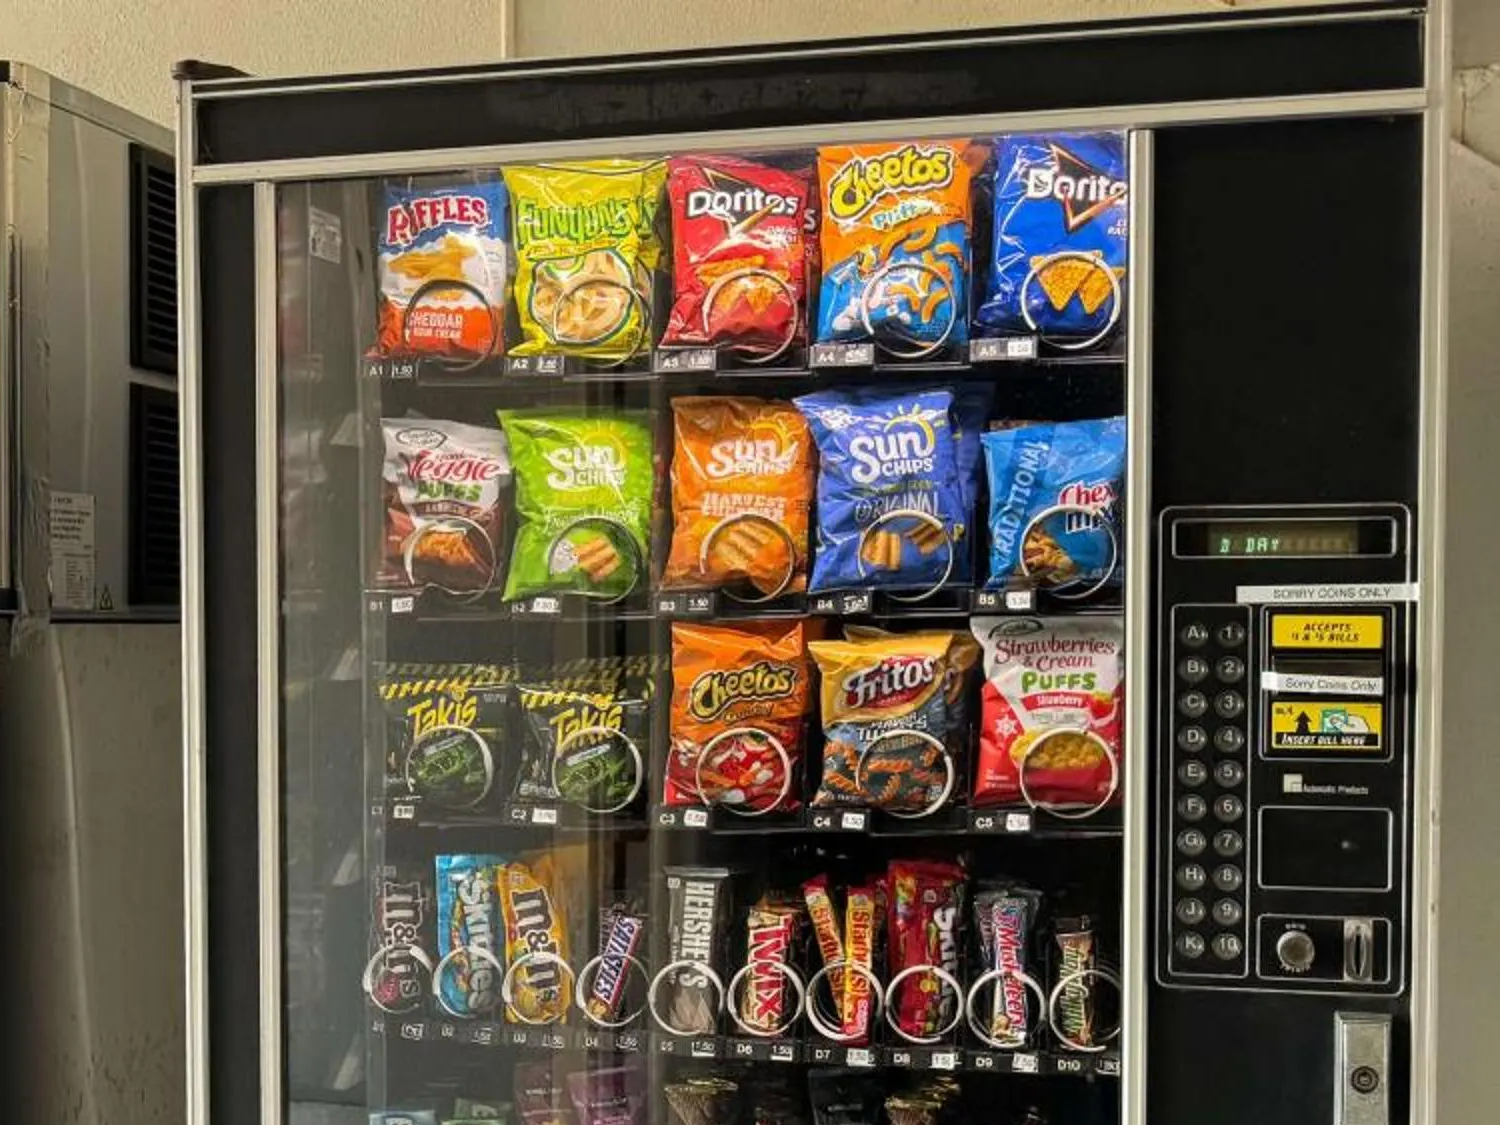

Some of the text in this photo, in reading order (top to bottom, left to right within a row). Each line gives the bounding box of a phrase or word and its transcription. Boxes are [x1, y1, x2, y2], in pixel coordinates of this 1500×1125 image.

[828, 144, 952, 220] Cheetos
[687, 187, 800, 217] Doritos
[512, 358, 528, 369] A2
[850, 429, 924, 484] Sun
[882, 457, 933, 475] CHIPS
[1059, 480, 1119, 507] Chex
[1245, 537, 1281, 553] DAY
[1317, 588, 1356, 600] COINS
[1359, 587, 1392, 599] ONLY
[1187, 625, 1199, 638] A
[1224, 626, 1232, 638] 1
[1303, 623, 1351, 632] ACCEPTS
[994, 636, 1116, 666] Strawberries
[1036, 653, 1097, 669] Cream
[1187, 660, 1199, 673] B
[1224, 661, 1235, 673] 2
[843, 655, 938, 710] Fritos
[1020, 671, 1097, 693] PUFFS
[692, 663, 792, 718] Cheetos
[1187, 695, 1199, 707] C
[1223, 695, 1234, 708] 3
[408, 694, 477, 739] Takis
[549, 704, 623, 748] Takis
[1187, 730, 1199, 742] D
[1222, 730, 1234, 743] 4
[1187, 764, 1198, 777] E
[1223, 764, 1234, 777] 5
[1187, 799, 1198, 812] F
[1223, 799, 1234, 812] 6
[814, 816, 831, 827] C4
[975, 816, 993, 828] C5
[1185, 834, 1198, 847] G
[1222, 834, 1233, 847] 7
[1185, 868, 1198, 880] H
[1222, 868, 1233, 881] 8
[1185, 902, 1196, 915] J
[1222, 903, 1233, 916] 9
[1185, 937, 1198, 949] K
[1219, 937, 1236, 951] 10
[737, 1043, 753, 1055] D6
[815, 1048, 831, 1060] D7
[894, 1052, 911, 1065] D8
[975, 1056, 993, 1068] D9
[1057, 1059, 1081, 1071] D10
